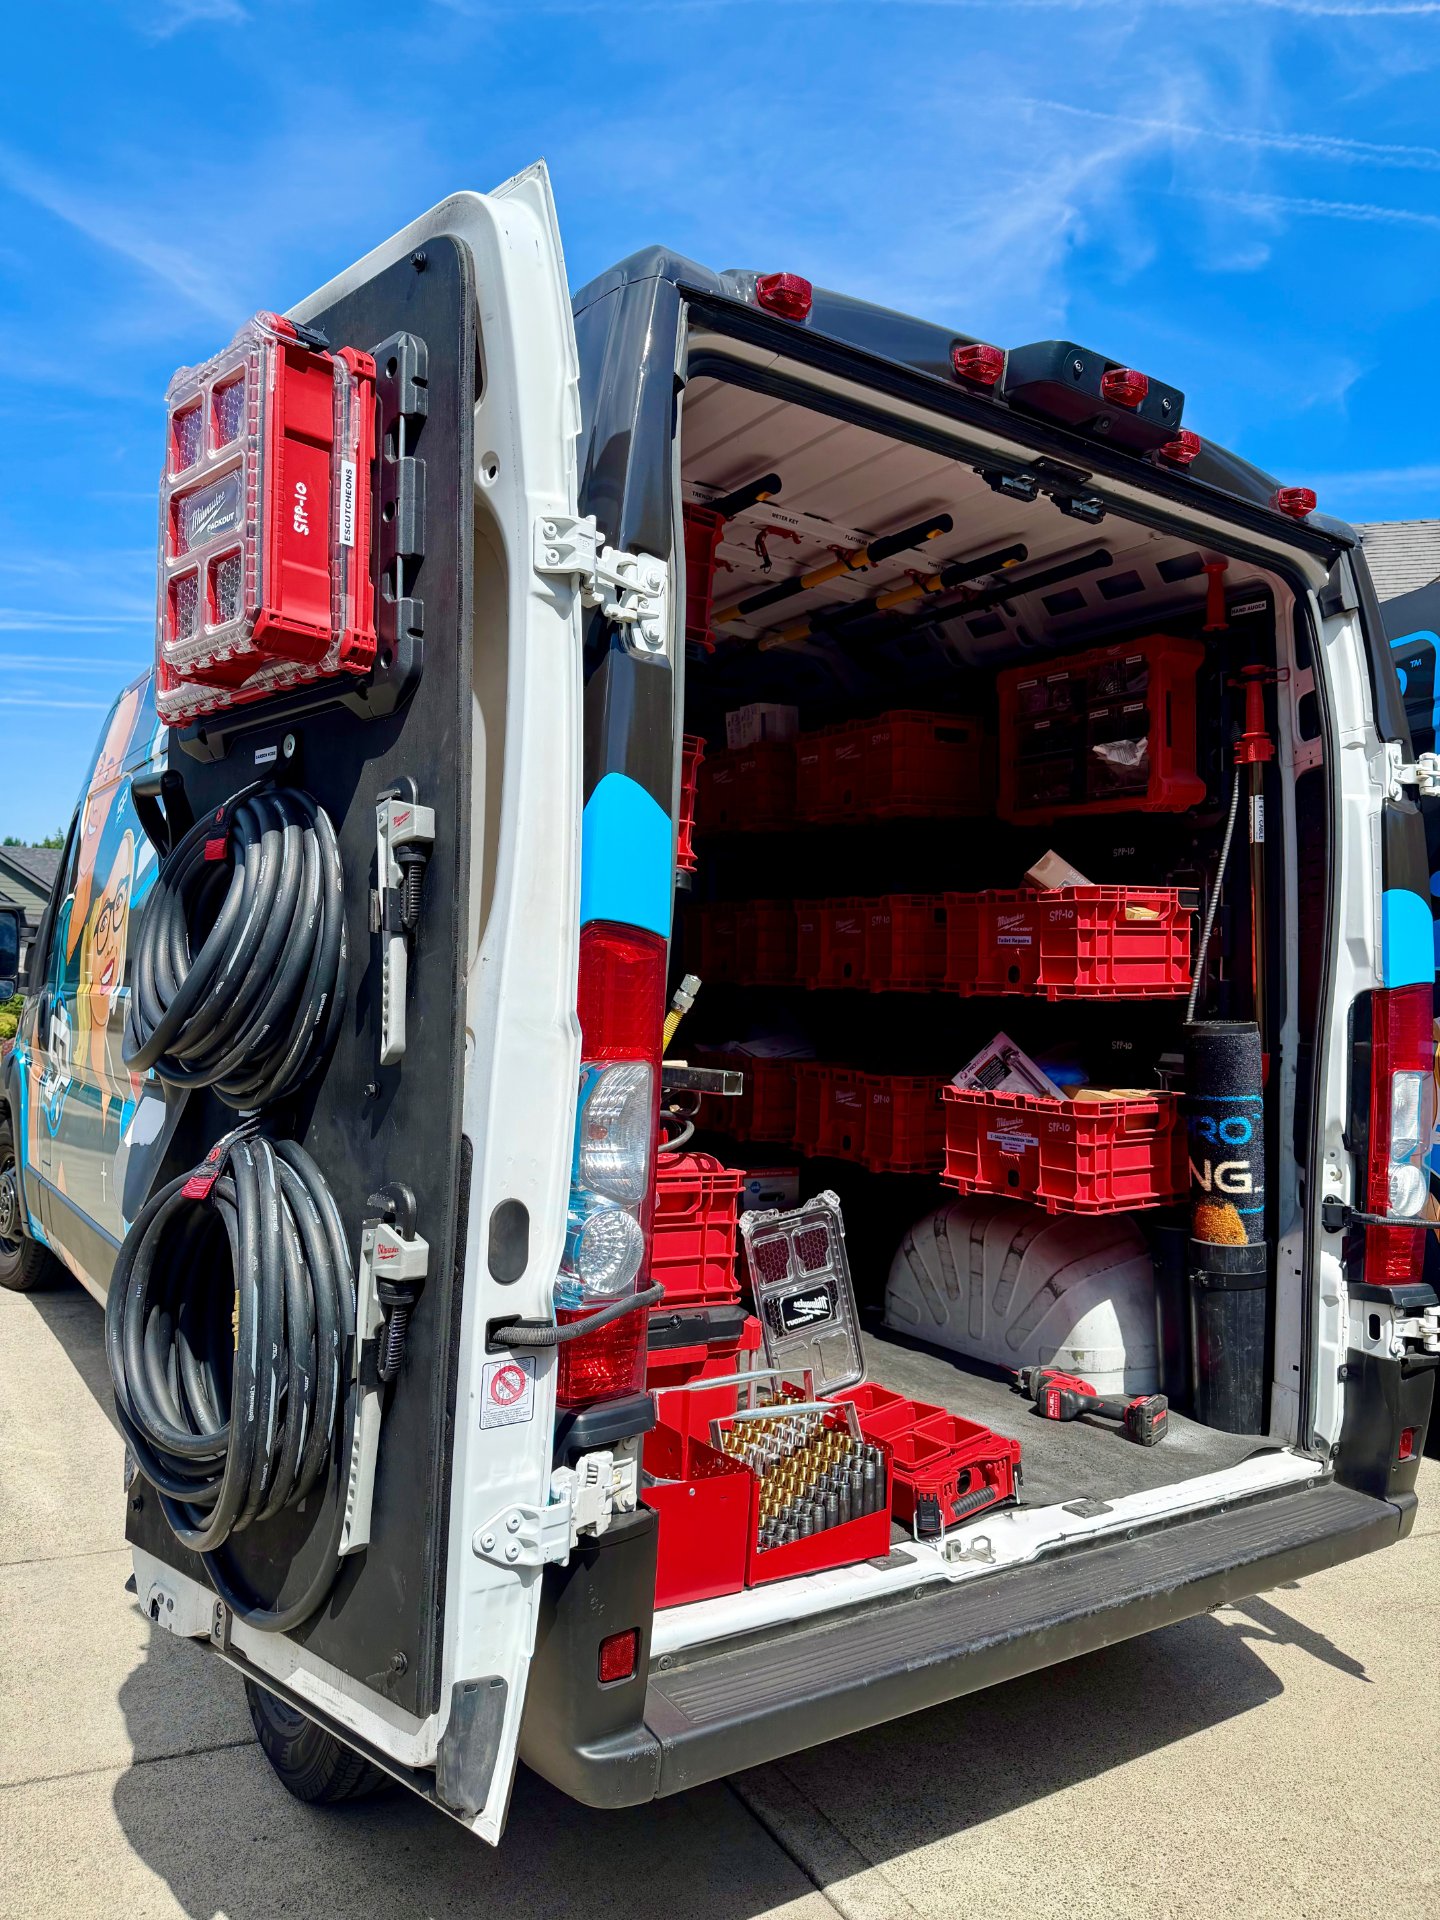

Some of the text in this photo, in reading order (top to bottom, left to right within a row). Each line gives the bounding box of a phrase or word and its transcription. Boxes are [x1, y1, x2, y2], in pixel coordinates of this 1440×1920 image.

[191, 490, 226, 532] Milwaukee
[343, 468, 354, 542] ESCUTCHEONS
[206, 511, 235, 533] PACKOUT
[771, 512, 799, 526] METER KEY
[1231, 606, 1247, 615] HAND
[1410, 658, 1422, 668] TM
[997, 912, 1025, 928] Milwaukee
[1049, 909, 1074, 922] SPP-10
[996, 1116, 1024, 1129] Milwaukee
[1048, 1122, 1071, 1133] SPP-10
